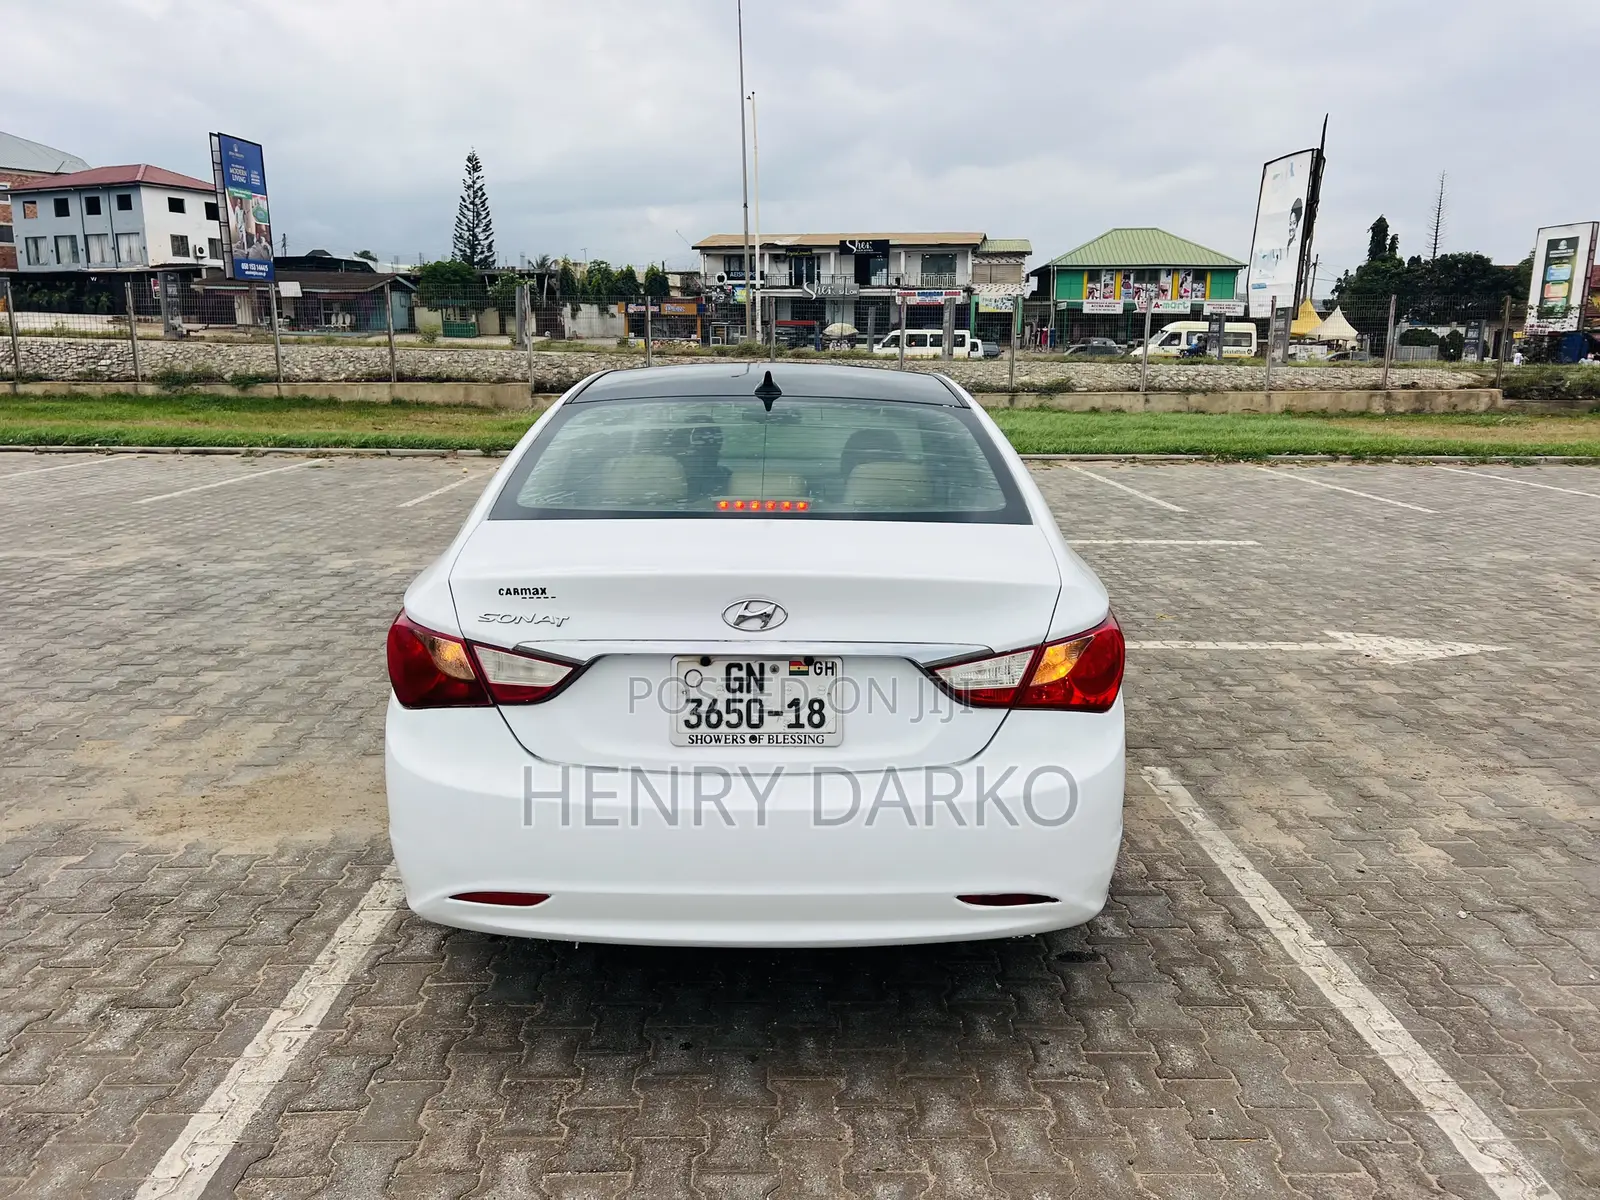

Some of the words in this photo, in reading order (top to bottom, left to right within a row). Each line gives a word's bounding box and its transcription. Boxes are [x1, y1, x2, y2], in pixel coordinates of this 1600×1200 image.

[478, 613, 570, 627] SONAT
[725, 662, 765, 694] GN
[813, 661, 835, 676] GH
[684, 698, 826, 729] 3650-18
[688, 734, 746, 745] SHOWERS
[767, 734, 825, 745] BLESSING
